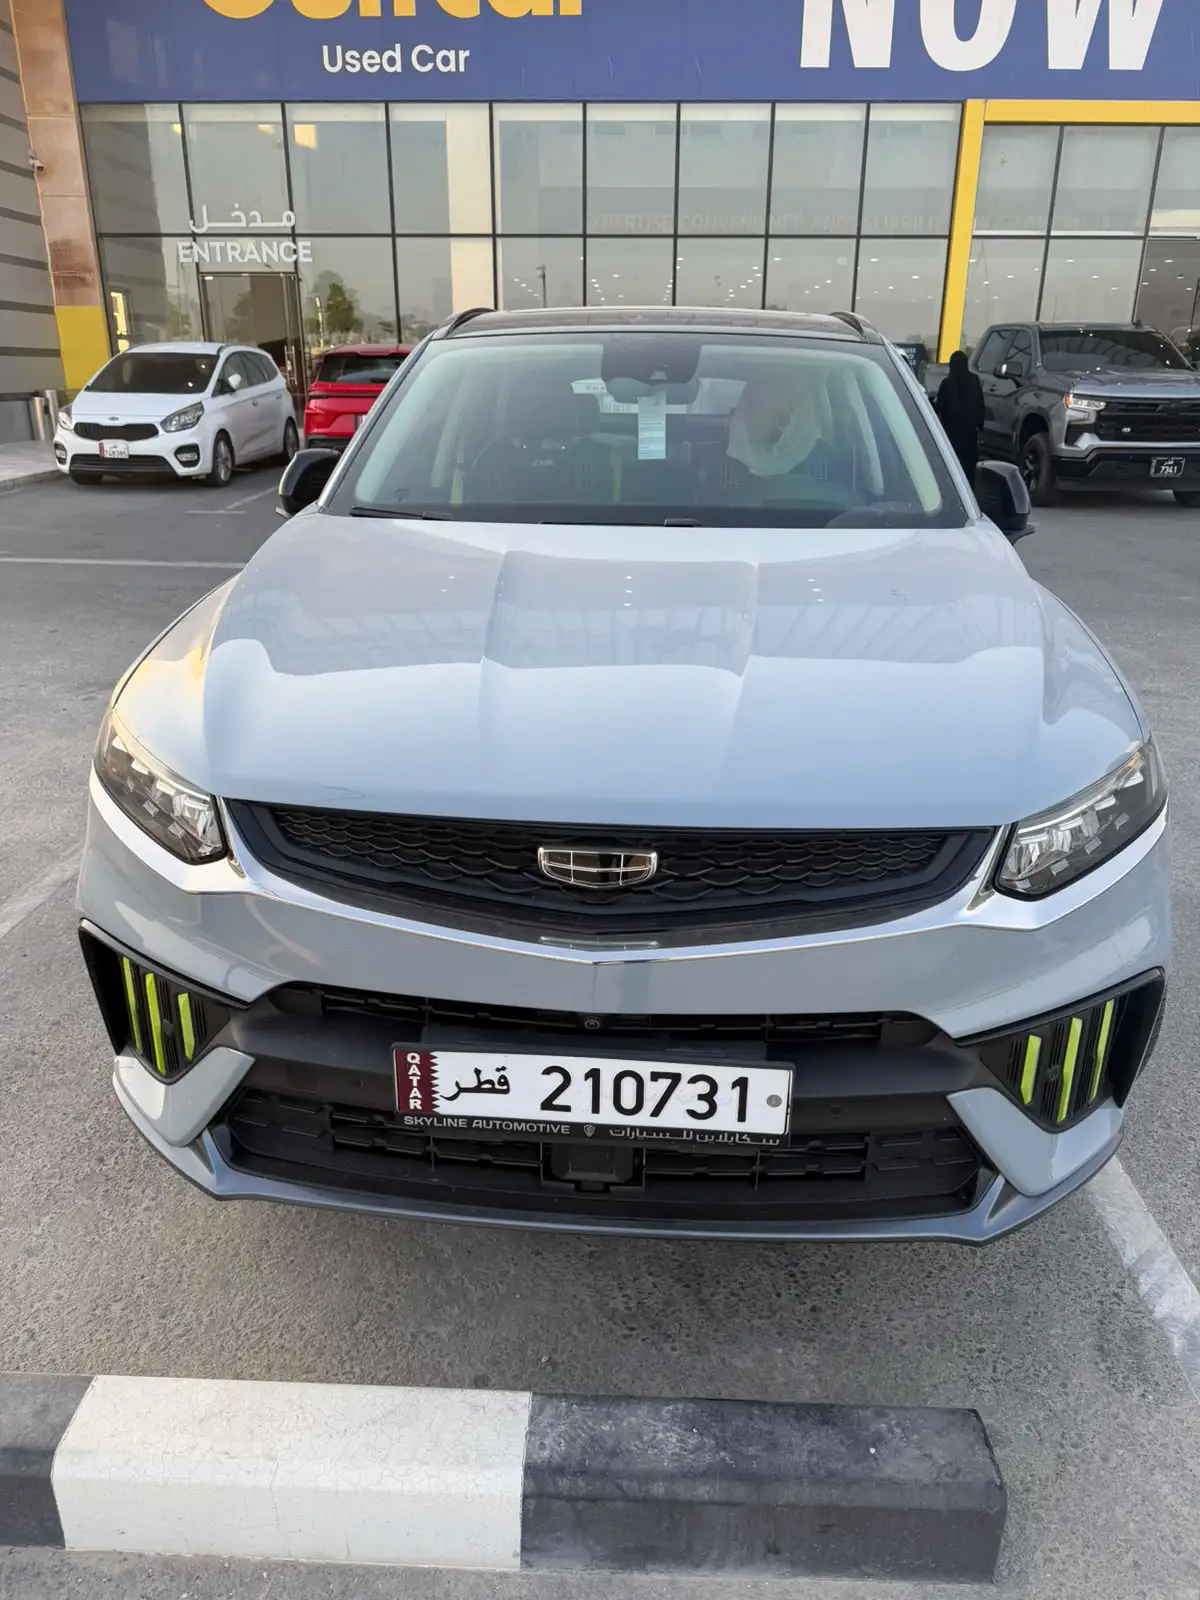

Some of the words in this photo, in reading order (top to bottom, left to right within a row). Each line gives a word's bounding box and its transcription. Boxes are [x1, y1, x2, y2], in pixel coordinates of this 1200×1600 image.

[322, 44, 402, 73] Used
[411, 44, 471, 73] Car
[188, 203, 296, 233] مدخل
[587, 213, 673, 230] XPERTISE
[177, 241, 314, 264] ENTRANCE
[406, 1052, 423, 1110] QATAR
[439, 1065, 511, 1102] قطر
[540, 1065, 749, 1123] 210731
[403, 1115, 468, 1129] SKYLINE
[472, 1120, 571, 1135] AUTOMOTIVE
